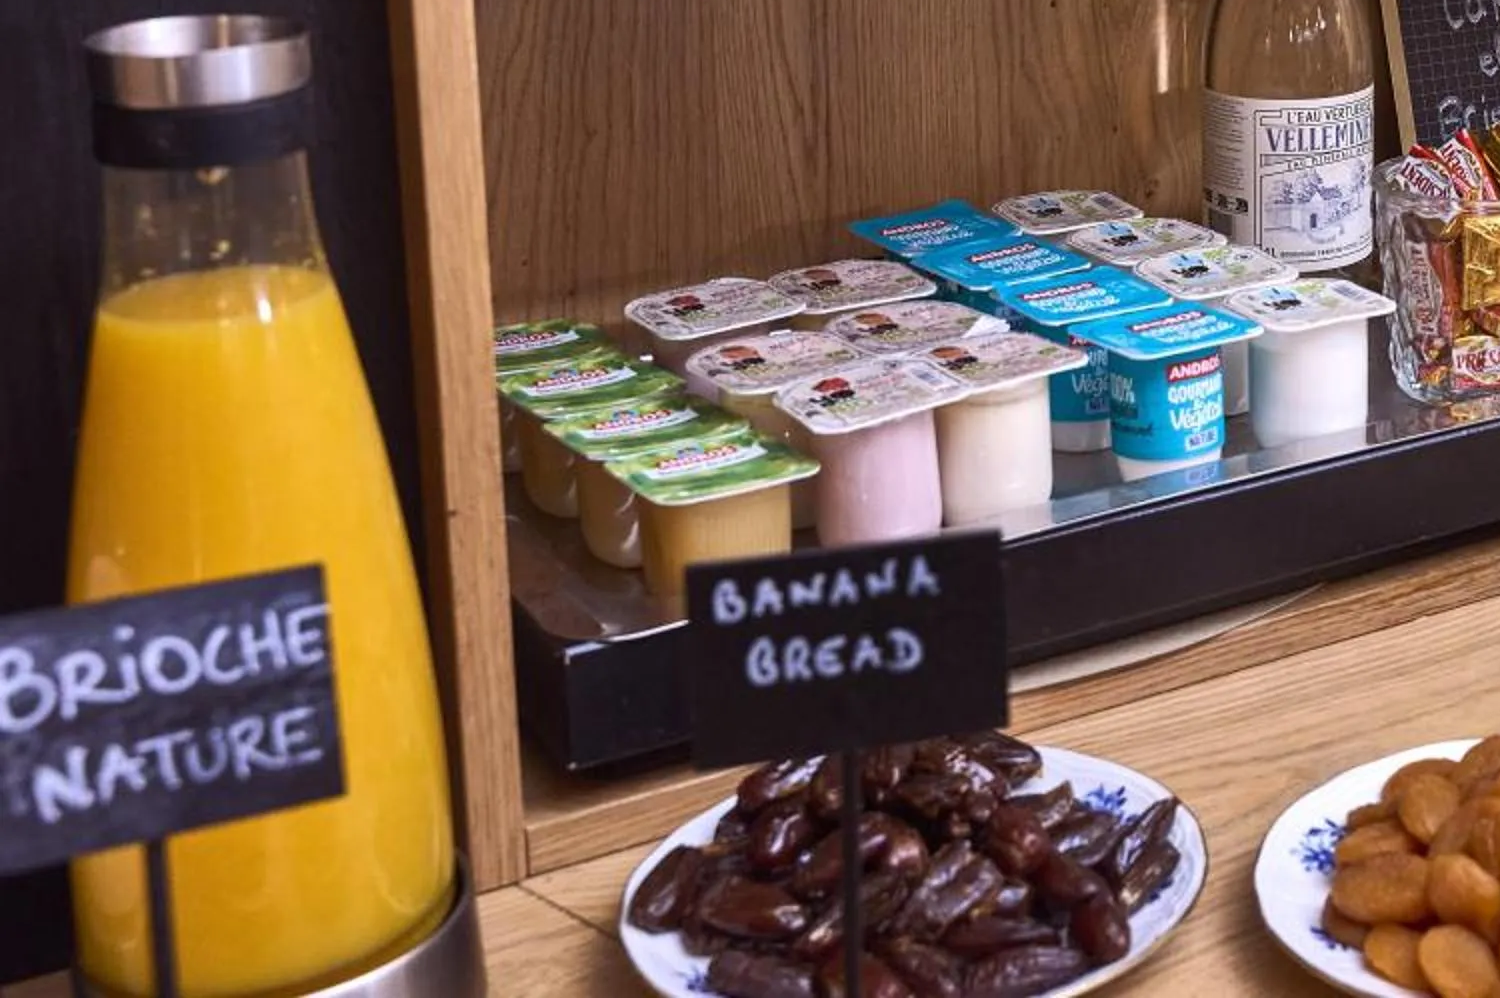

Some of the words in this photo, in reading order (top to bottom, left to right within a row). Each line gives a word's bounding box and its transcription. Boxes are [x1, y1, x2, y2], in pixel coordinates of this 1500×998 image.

[1266, 115, 1371, 153] VELLEMIN
[711, 554, 941, 626] BANANA
[744, 626, 925, 687] BREAD
[33, 705, 323, 824] NATURE
